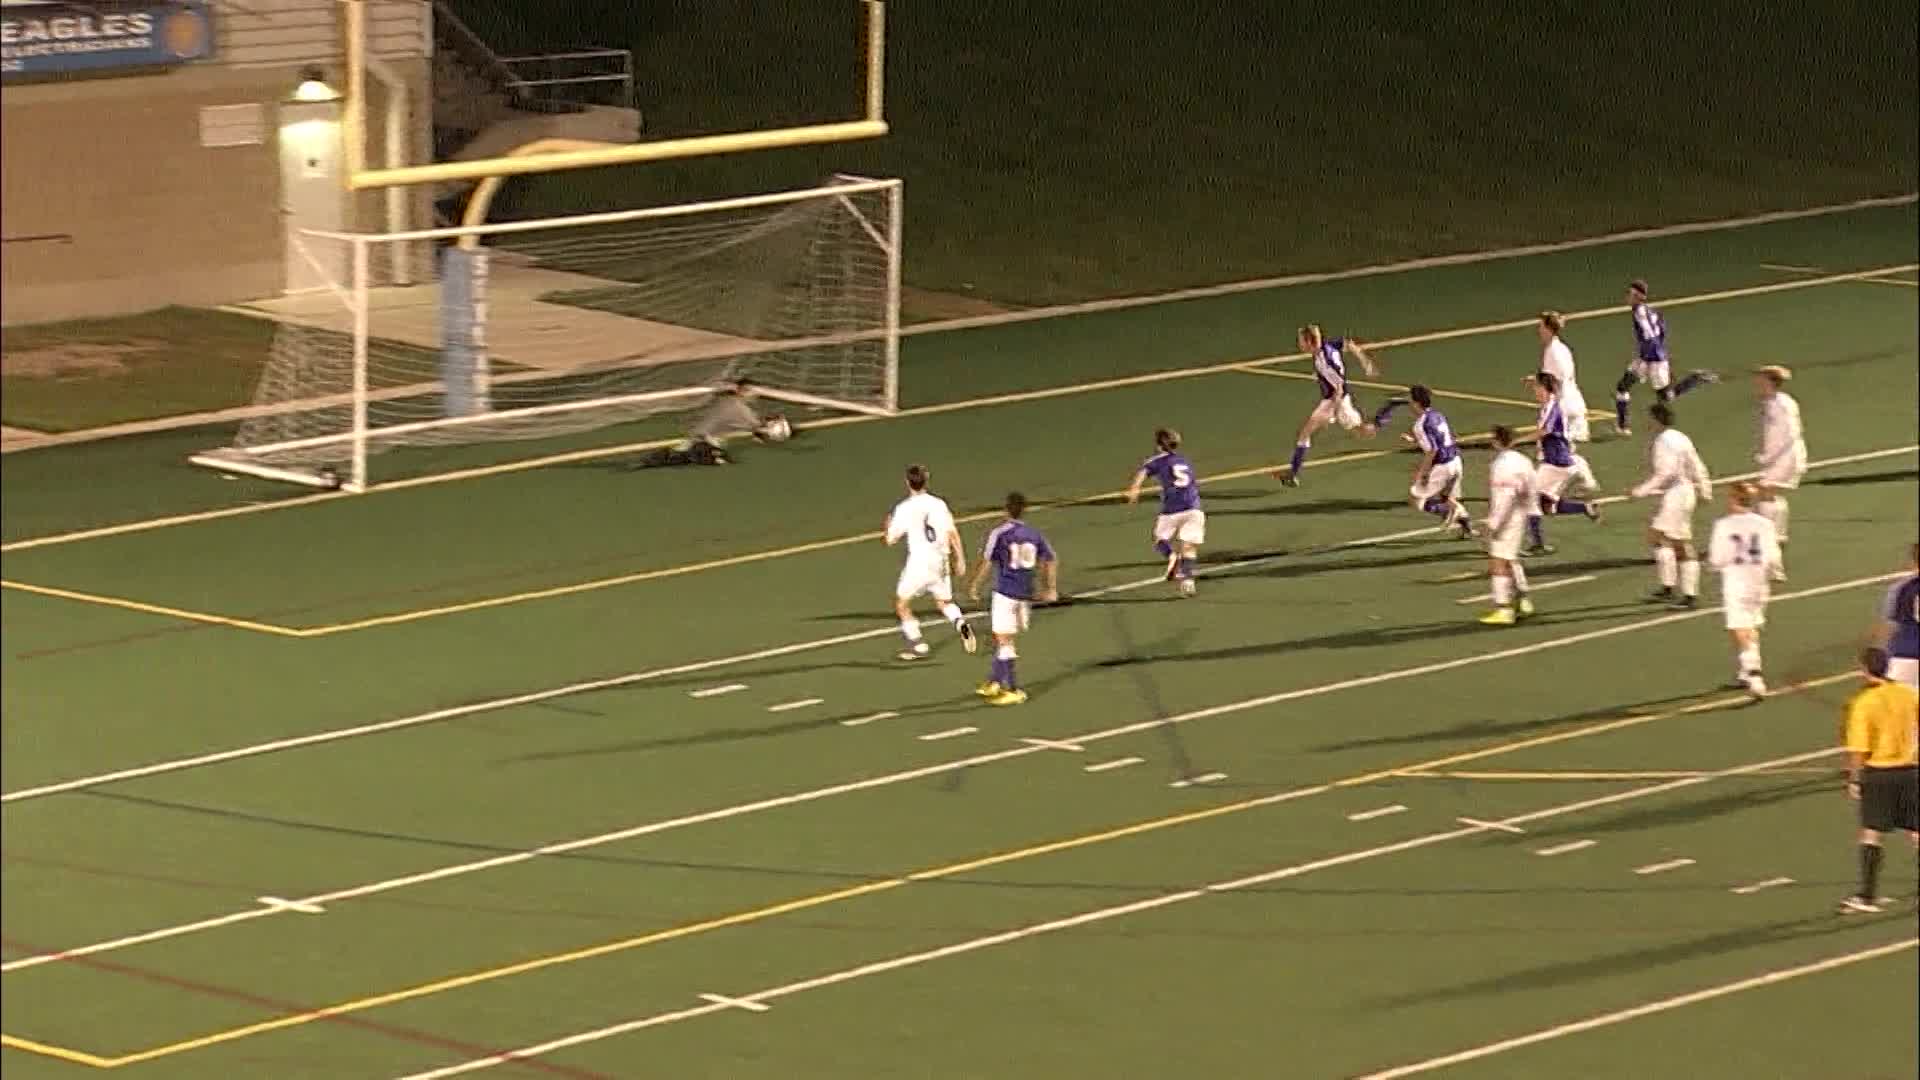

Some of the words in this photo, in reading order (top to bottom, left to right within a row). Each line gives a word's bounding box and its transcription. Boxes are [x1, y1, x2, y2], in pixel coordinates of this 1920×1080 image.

[1, 13, 153, 42] EAGLES
[1172, 463, 1190, 488] 5
[924, 512, 937, 543] 6
